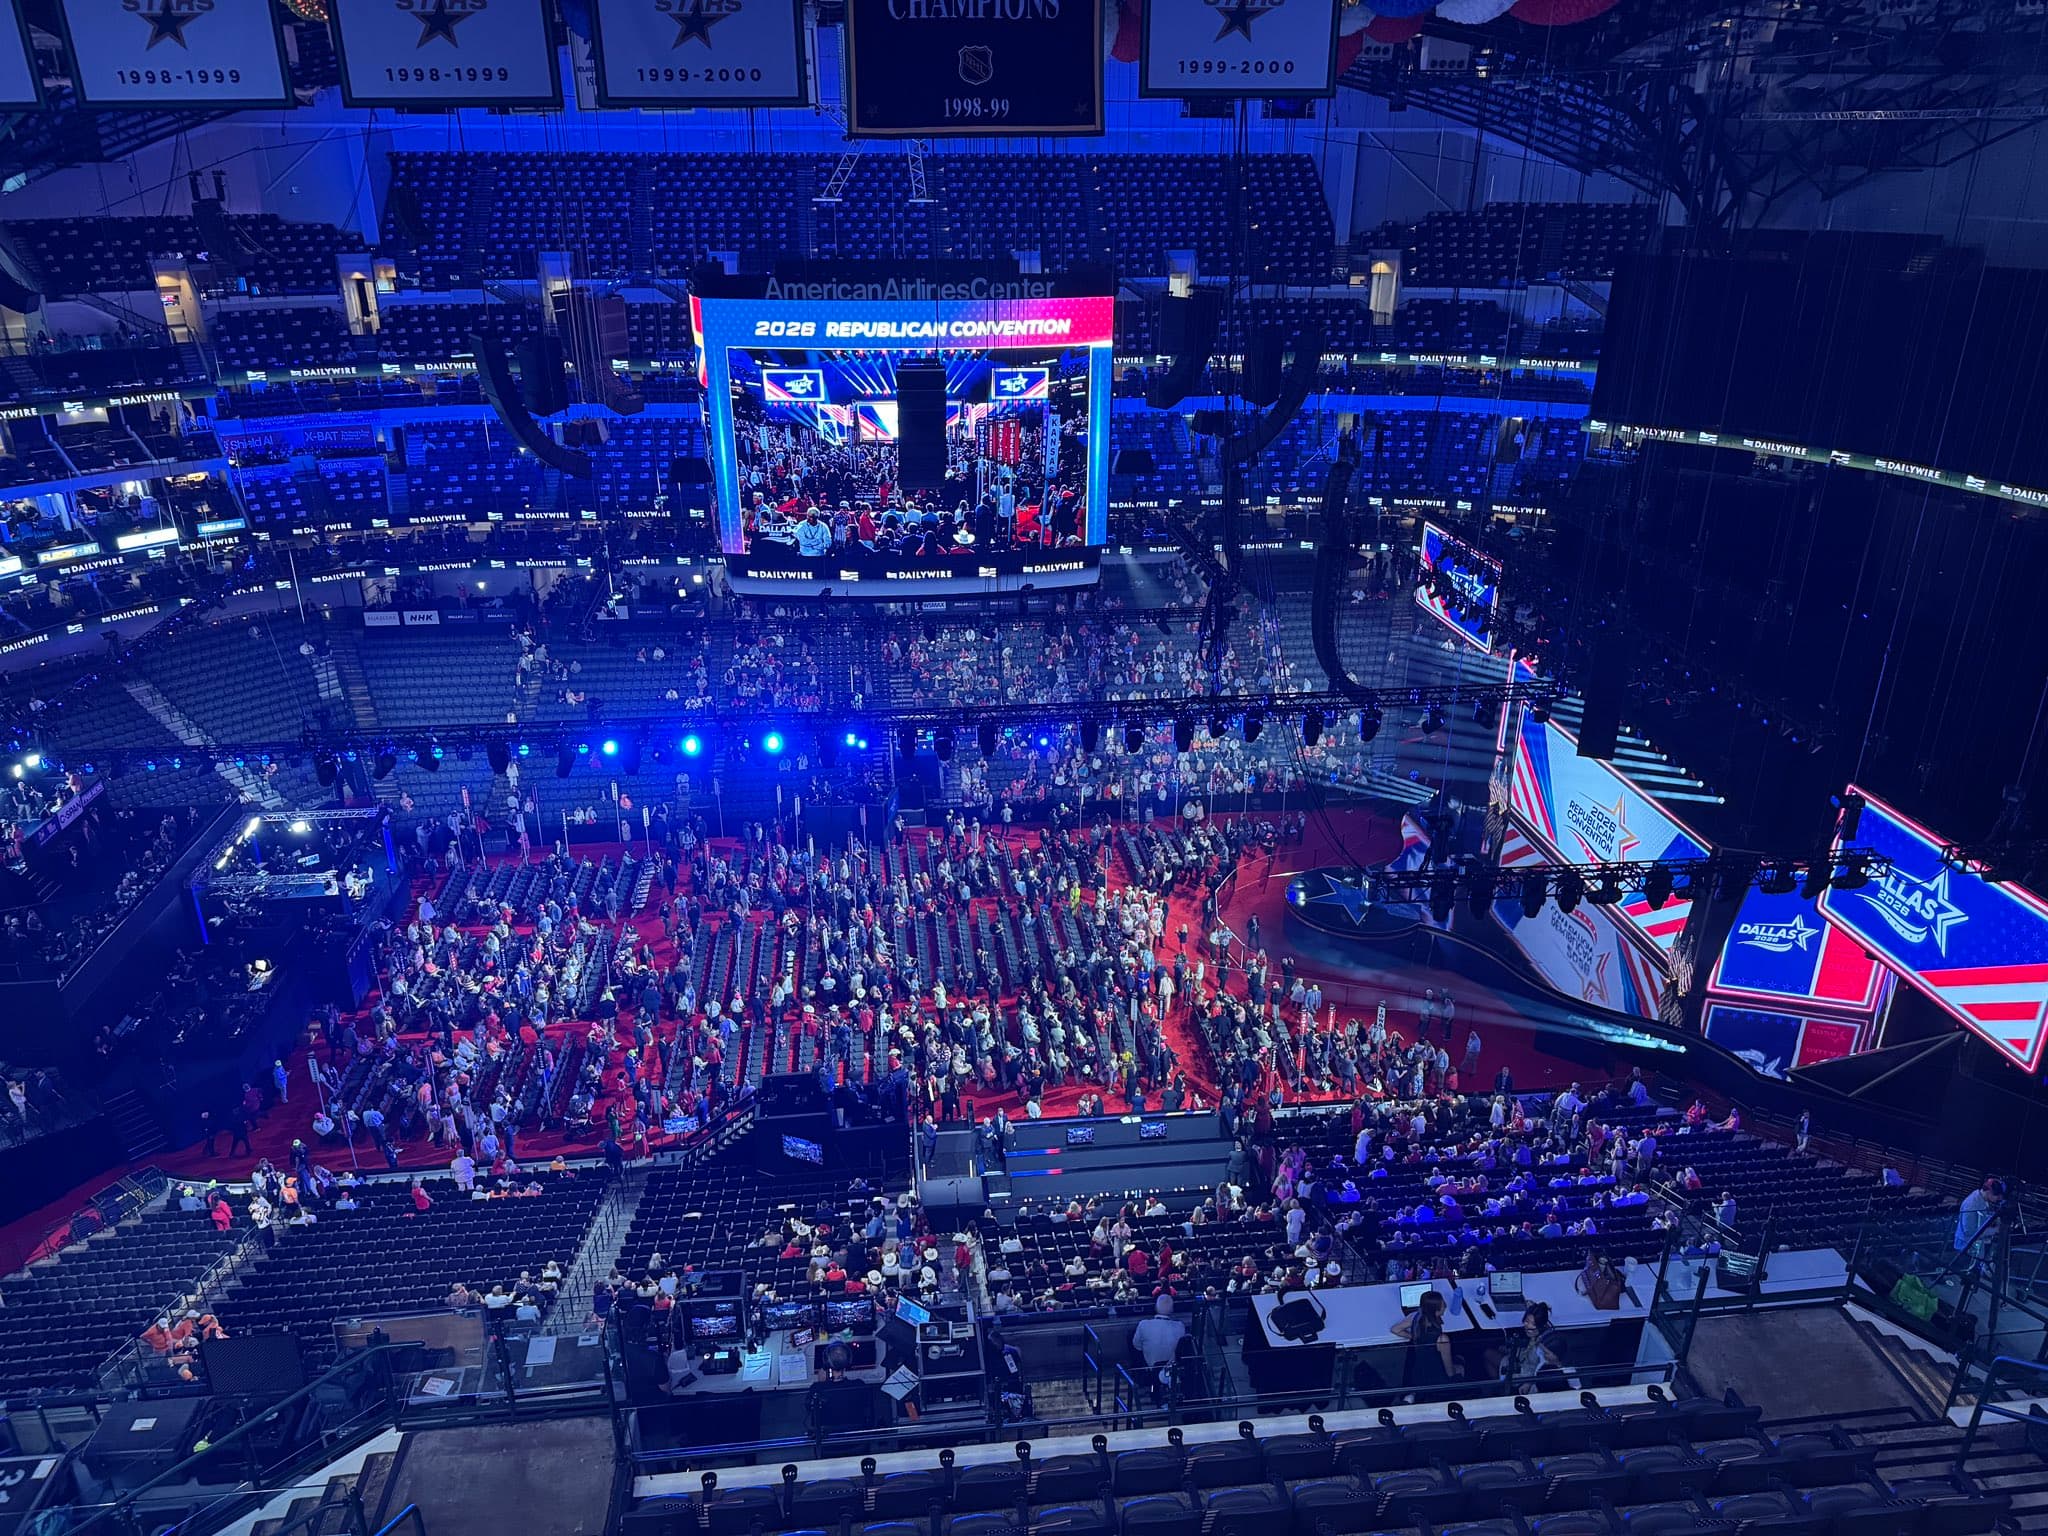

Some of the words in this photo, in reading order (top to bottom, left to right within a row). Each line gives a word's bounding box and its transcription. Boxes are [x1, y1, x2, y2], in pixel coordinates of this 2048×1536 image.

[887, 0, 1060, 20] CHAMPIONS
[1178, 60, 1295, 74] 1999-2000
[117, 69, 241, 84] 1998-1999
[385, 67, 509, 82] 1998-1999
[637, 68, 762, 82] 1999-2000
[943, 97, 1011, 118] 1998-99
[825, 321, 948, 339] REPUBLICAN
[949, 318, 1072, 338] CONVENTION
[427, 362, 478, 371] DAILYWIRE
[1531, 359, 1581, 369] DAILYWIRE
[302, 366, 358, 378] DAILYWIRE
[121, 391, 181, 406] DAILYWIRE
[303, 431, 339, 443] X-BAT
[1049, 418, 1057, 474] KANSAS
[1754, 441, 1808, 456] DAILYWIRE
[1887, 461, 1941, 479] DAILYWIRE
[1403, 498, 1446, 508] DAILYWIRE
[420, 514, 467, 524] DAILYWIRE
[525, 512, 570, 520] DAILYWIRE
[190, 536, 240, 550] DAILYWIRE
[71, 556, 125, 573] DAILYWIRE
[429, 562, 471, 571] DAILYWIRE
[1034, 561, 1084, 573] DAILYWIRE
[322, 570, 366, 582] DAILYWIRE
[759, 571, 813, 580] DAILYWIRE
[898, 571, 953, 579] DAILYWIRE
[111, 605, 159, 621] DAILYWIRE
[410, 614, 434, 622] NHK
[2, 633, 49, 654] DAILYWIRE
[1569, 800, 1615, 845] REPUBLICAN
[1590, 806, 1617, 833] 2026
[1567, 810, 1613, 855] CONVENTION
[1738, 923, 1798, 940] DALLAS
